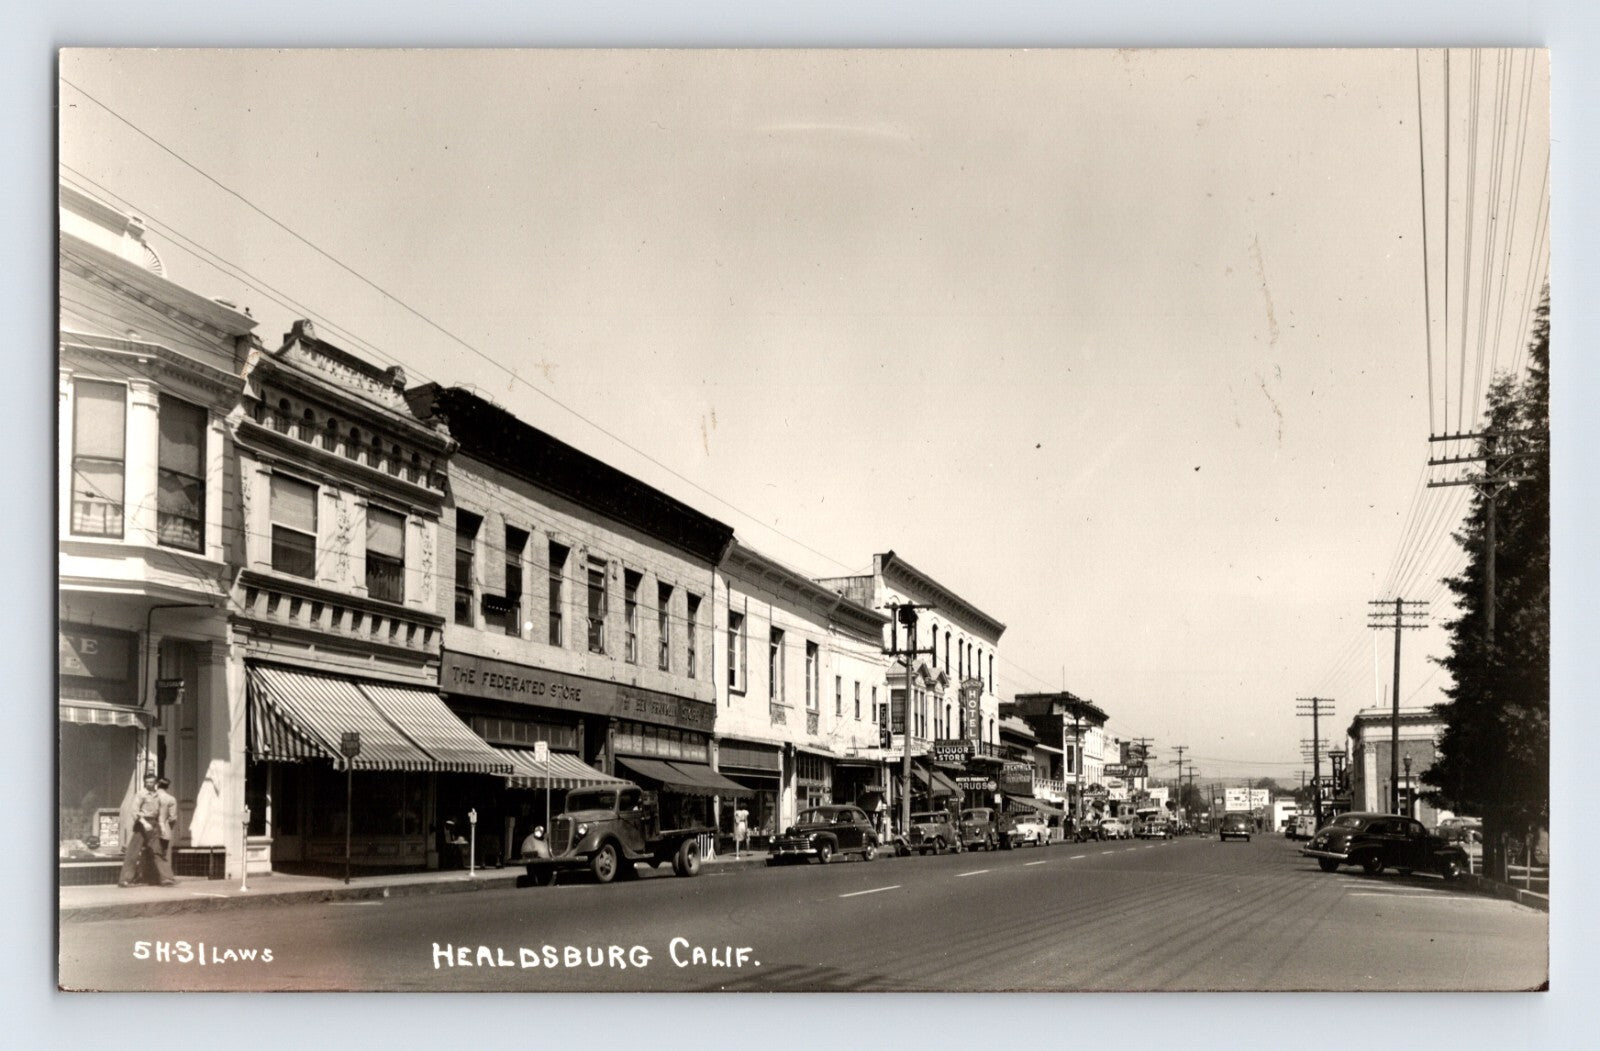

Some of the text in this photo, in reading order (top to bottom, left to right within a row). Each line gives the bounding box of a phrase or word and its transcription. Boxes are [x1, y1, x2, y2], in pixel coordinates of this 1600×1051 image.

[452, 666, 582, 702] THE FEDERATED STORE
[968, 689, 977, 738] HOTEL
[936, 747, 969, 755] LIQUOR
[958, 782, 988, 791] DRUGS
